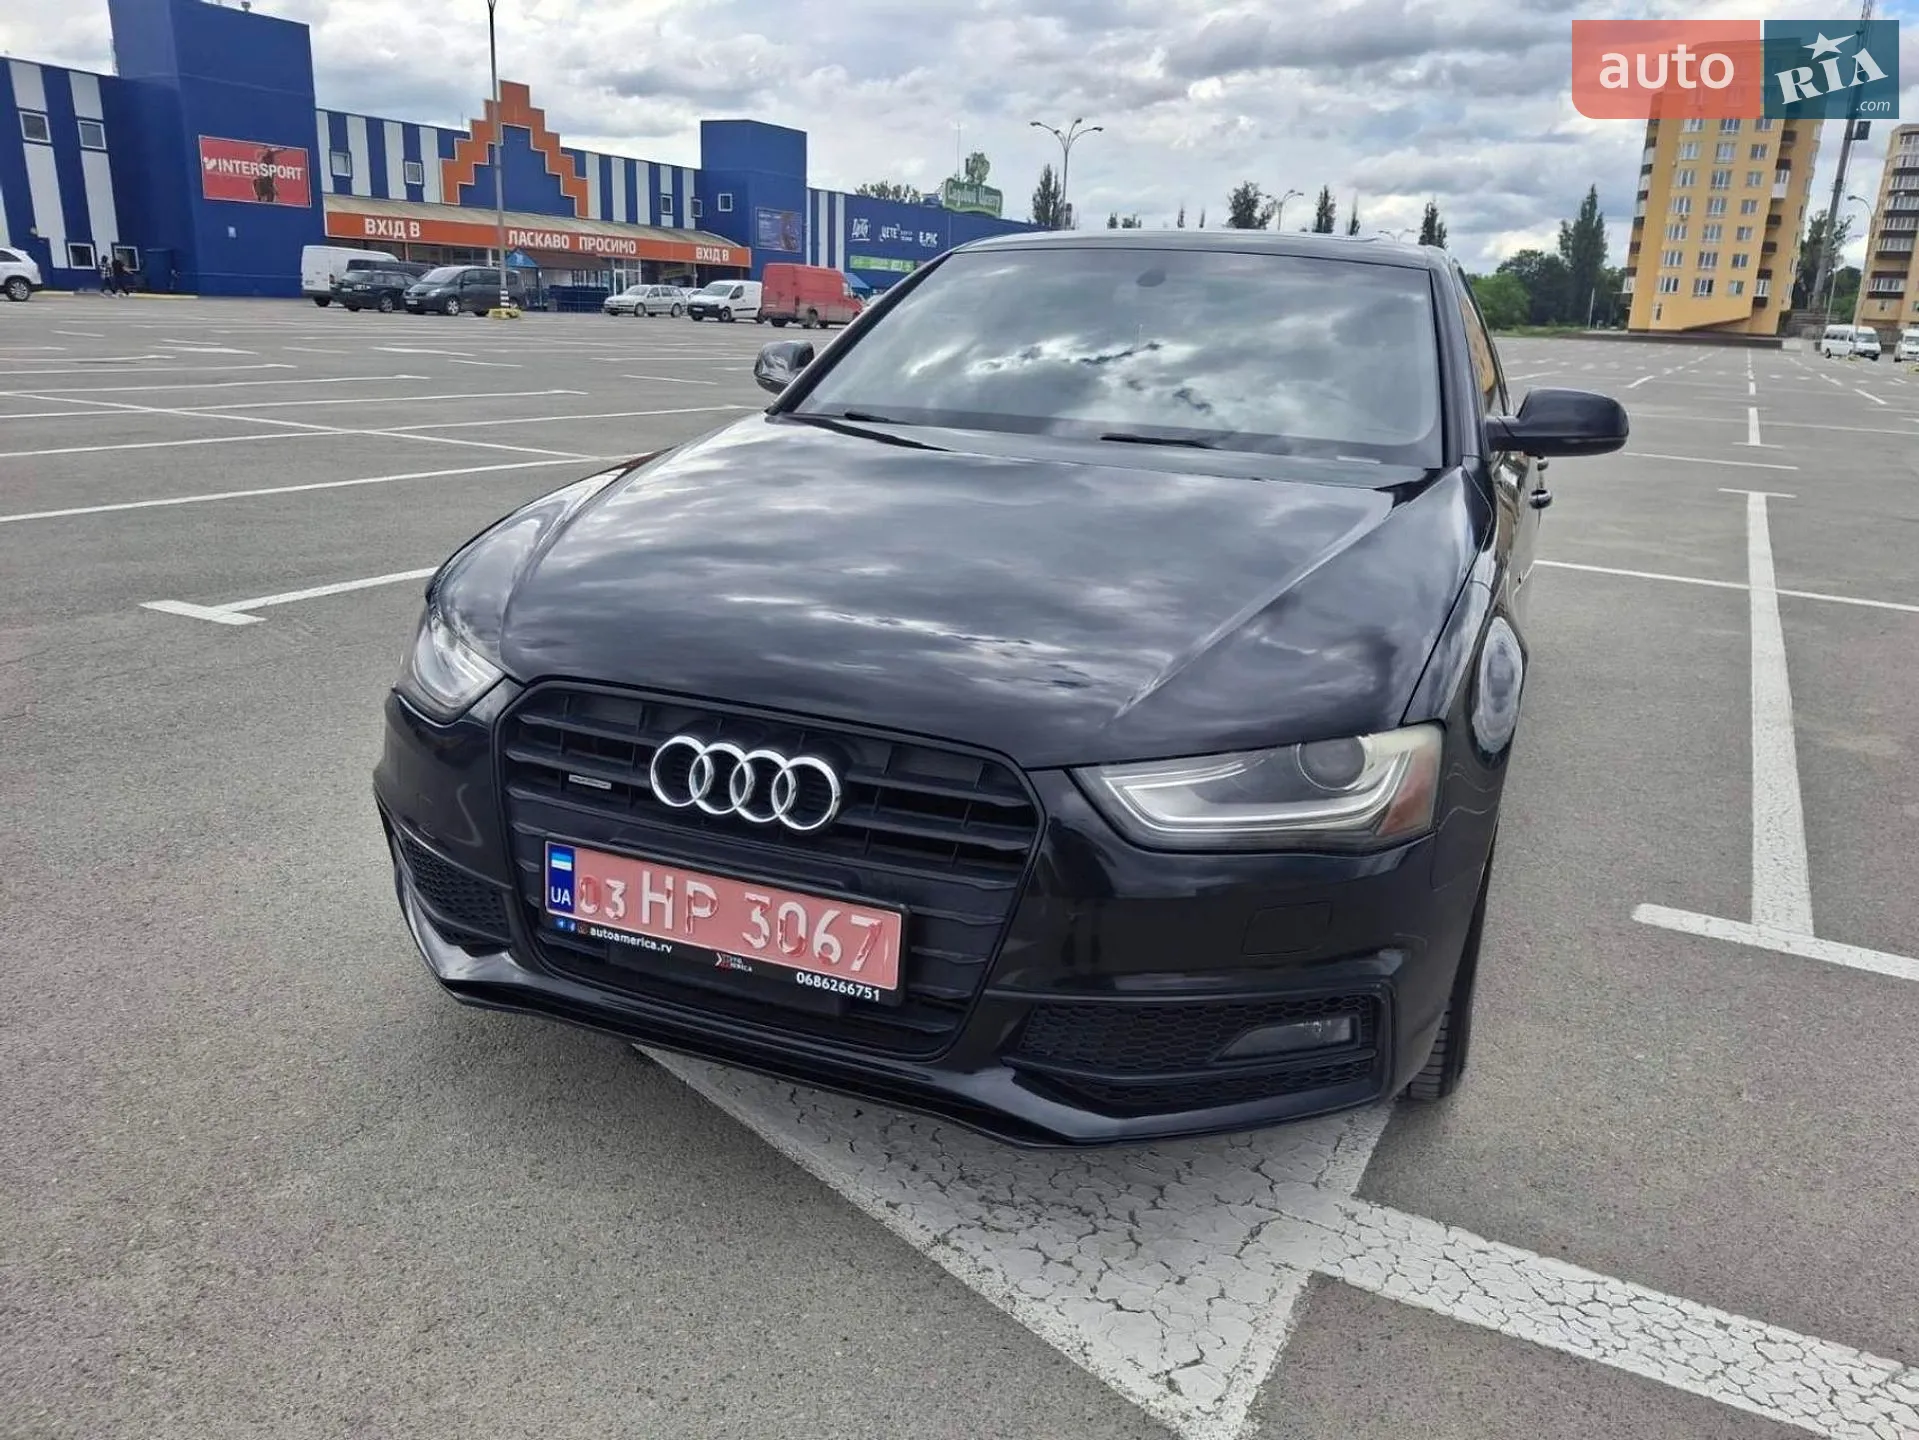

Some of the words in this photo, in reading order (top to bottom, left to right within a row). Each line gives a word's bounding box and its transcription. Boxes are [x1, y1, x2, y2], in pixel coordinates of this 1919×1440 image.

[218, 158, 303, 180] INTERSPORT
[364, 217, 407, 239] ВХІД
[410, 221, 420, 238] В
[508, 230, 570, 249] ЛАСКАВО
[579, 236, 636, 255] ПРОСИМО
[696, 246, 721, 262] ВХІД
[723, 249, 729, 261] В
[551, 885, 572, 906] UA
[578, 874, 626, 920] 03
[642, 870, 719, 934] HP
[741, 892, 883, 972] 3067
[589, 925, 672, 954] autoamerica.rv
[796, 971, 880, 1002] 0686266751
